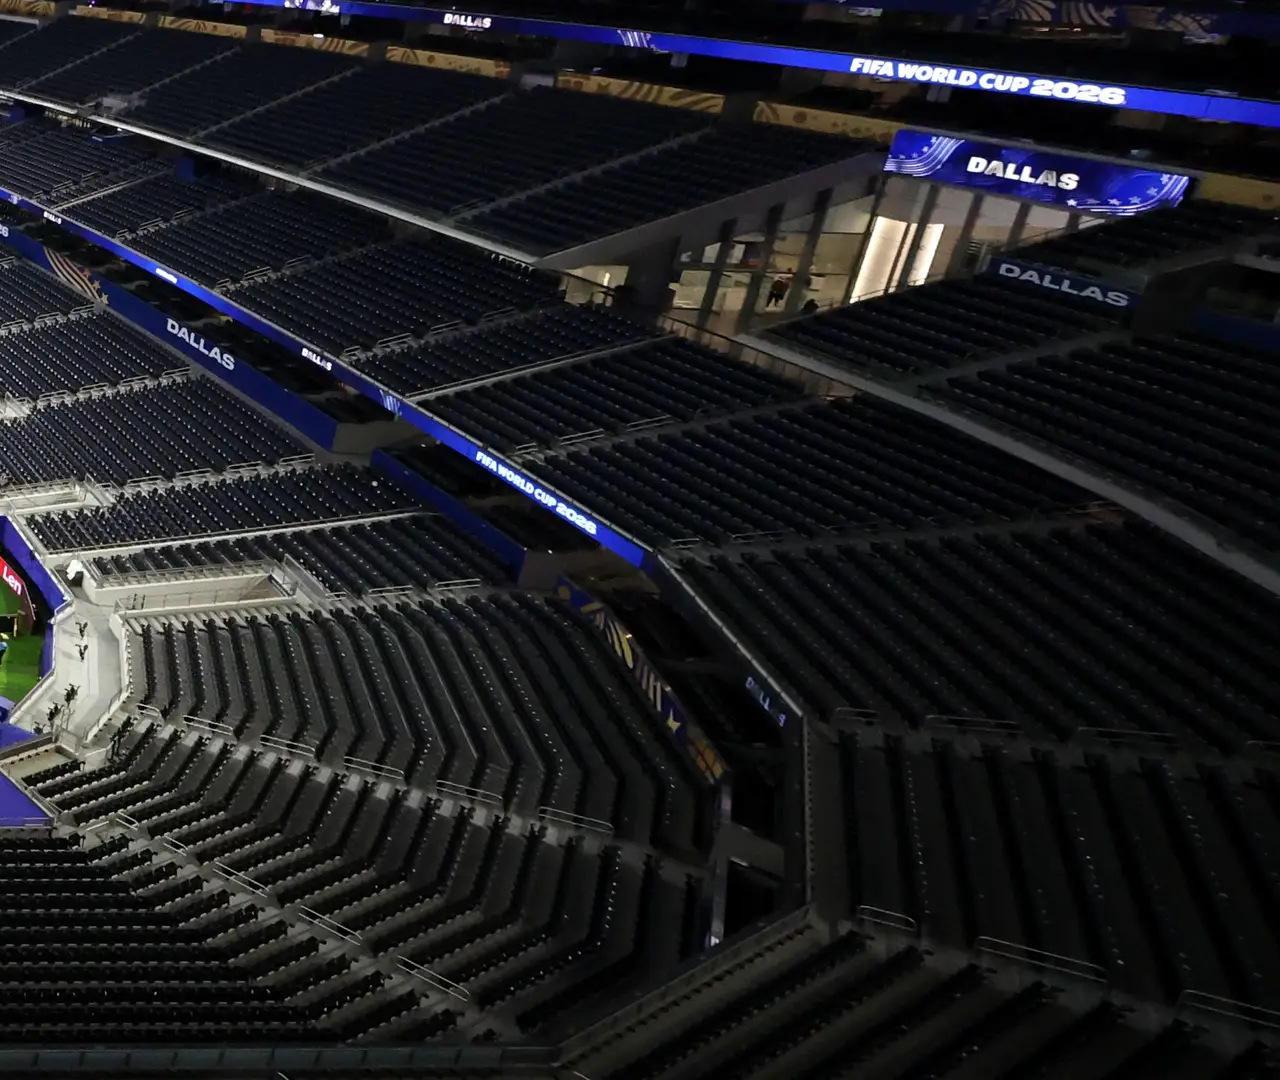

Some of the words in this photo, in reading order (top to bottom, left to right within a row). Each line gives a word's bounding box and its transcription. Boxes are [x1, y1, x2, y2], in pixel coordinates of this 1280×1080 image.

[444, 13, 491, 28] DALLAS
[850, 57, 894, 77] FIFA
[897, 63, 977, 88] WORLD
[978, 73, 1029, 94] CUP
[1029, 79, 1126, 106] 2026
[967, 156, 1080, 191] DALLAS
[1000, 263, 1129, 307] DALLAS
[167, 318, 235, 371] DALLAS
[301, 348, 332, 371] DALLAS
[476, 451, 497, 476] FIFA
[497, 466, 534, 497] WORLD
[533, 489, 557, 509] CUP
[555, 503, 597, 536] 2026
[2, 565, 23, 595] Len
